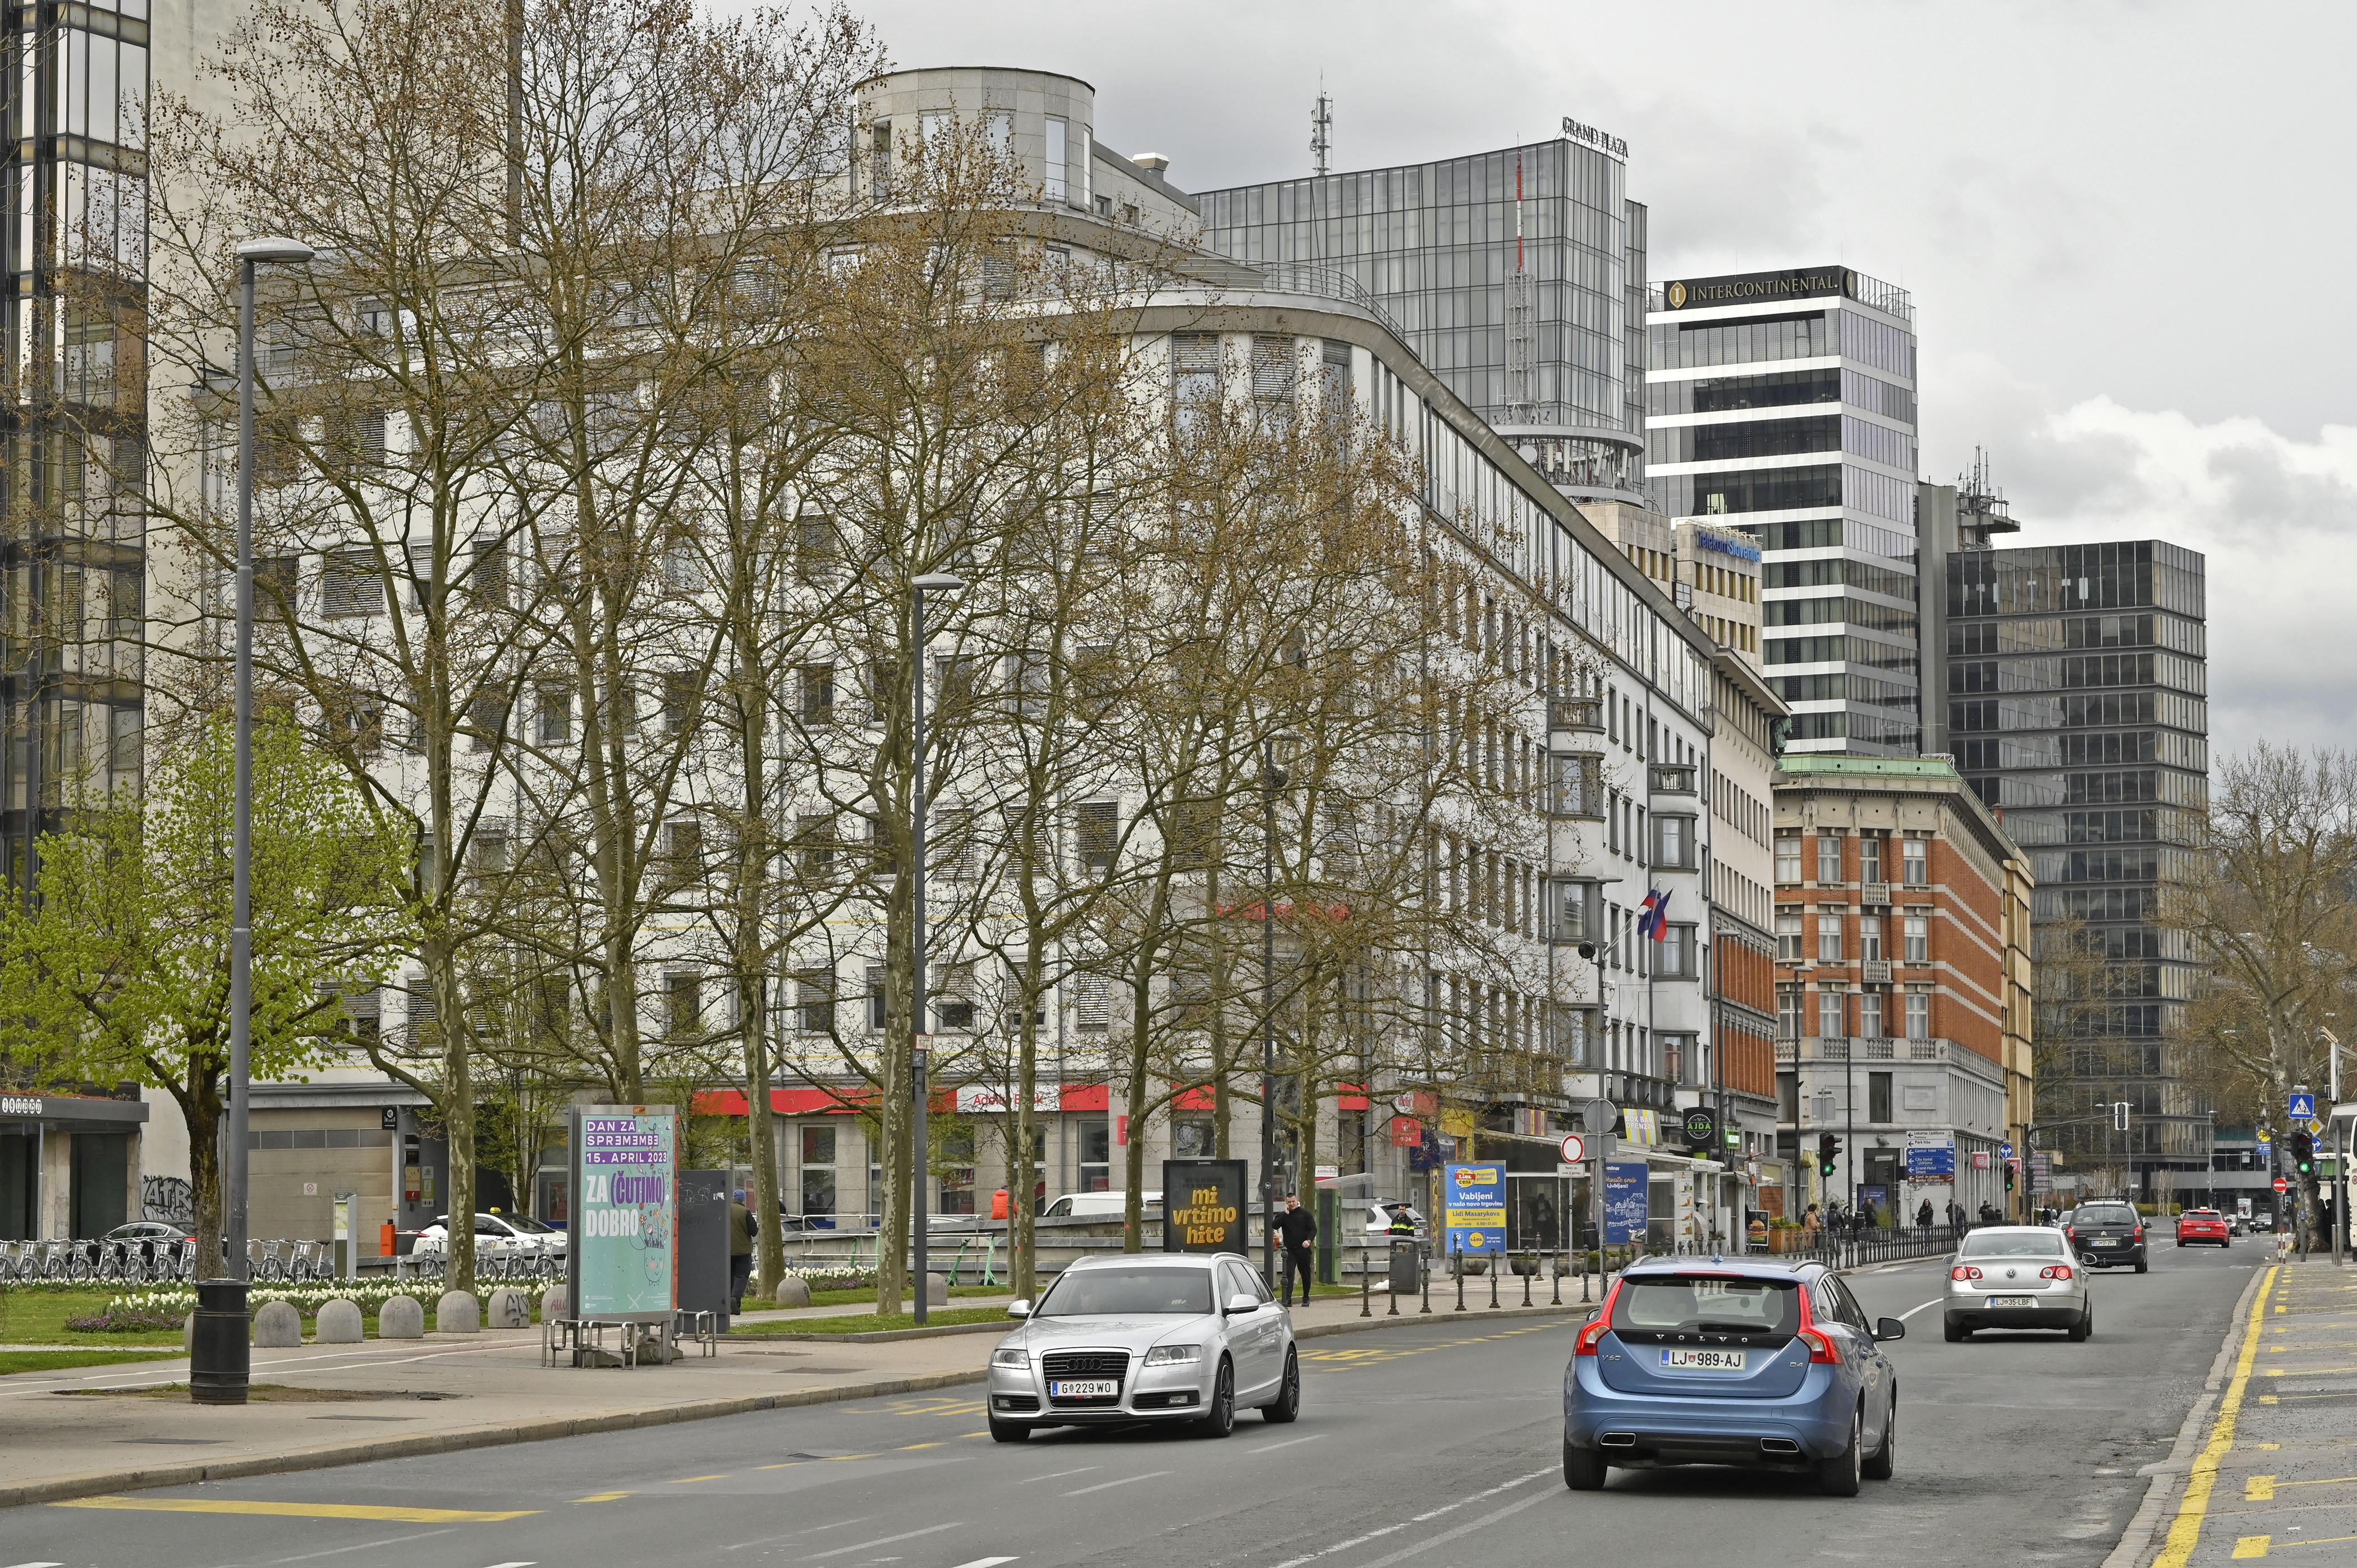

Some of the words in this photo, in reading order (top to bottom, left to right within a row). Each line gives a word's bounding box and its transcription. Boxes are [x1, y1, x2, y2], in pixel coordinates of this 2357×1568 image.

[1562, 116, 1598, 145] GRAND
[1602, 131, 1629, 158] PLAZA
[1697, 530, 1729, 554] Telekom
[1728, 539, 1760, 566] Slovenije
[16, 1101, 21, 1111] 12
[23, 1101, 28, 1111] 23
[587, 1121, 615, 1131] DAN
[620, 1121, 635, 1131] ZA
[586, 1153, 606, 1163] 15.
[611, 1152, 644, 1162] APRIL
[648, 1152, 667, 1162] 2023
[586, 1175, 608, 1202] ZA
[611, 1170, 665, 1209] (ČUTIMO)
[1192, 1186, 1218, 1205] mi
[1459, 1191, 1493, 1201] Vabljeni
[586, 1209, 639, 1237] DOBRO
[1173, 1205, 1237, 1225] vrtimo
[1187, 1225, 1225, 1244] hite
[1656, 1334, 1748, 1343] VOLVO
[1672, 1351, 1687, 1365] LJ
[1697, 1352, 1741, 1368] 989-AJ
[1062, 1383, 1067, 1393] G
[1075, 1383, 1094, 1393] 229
